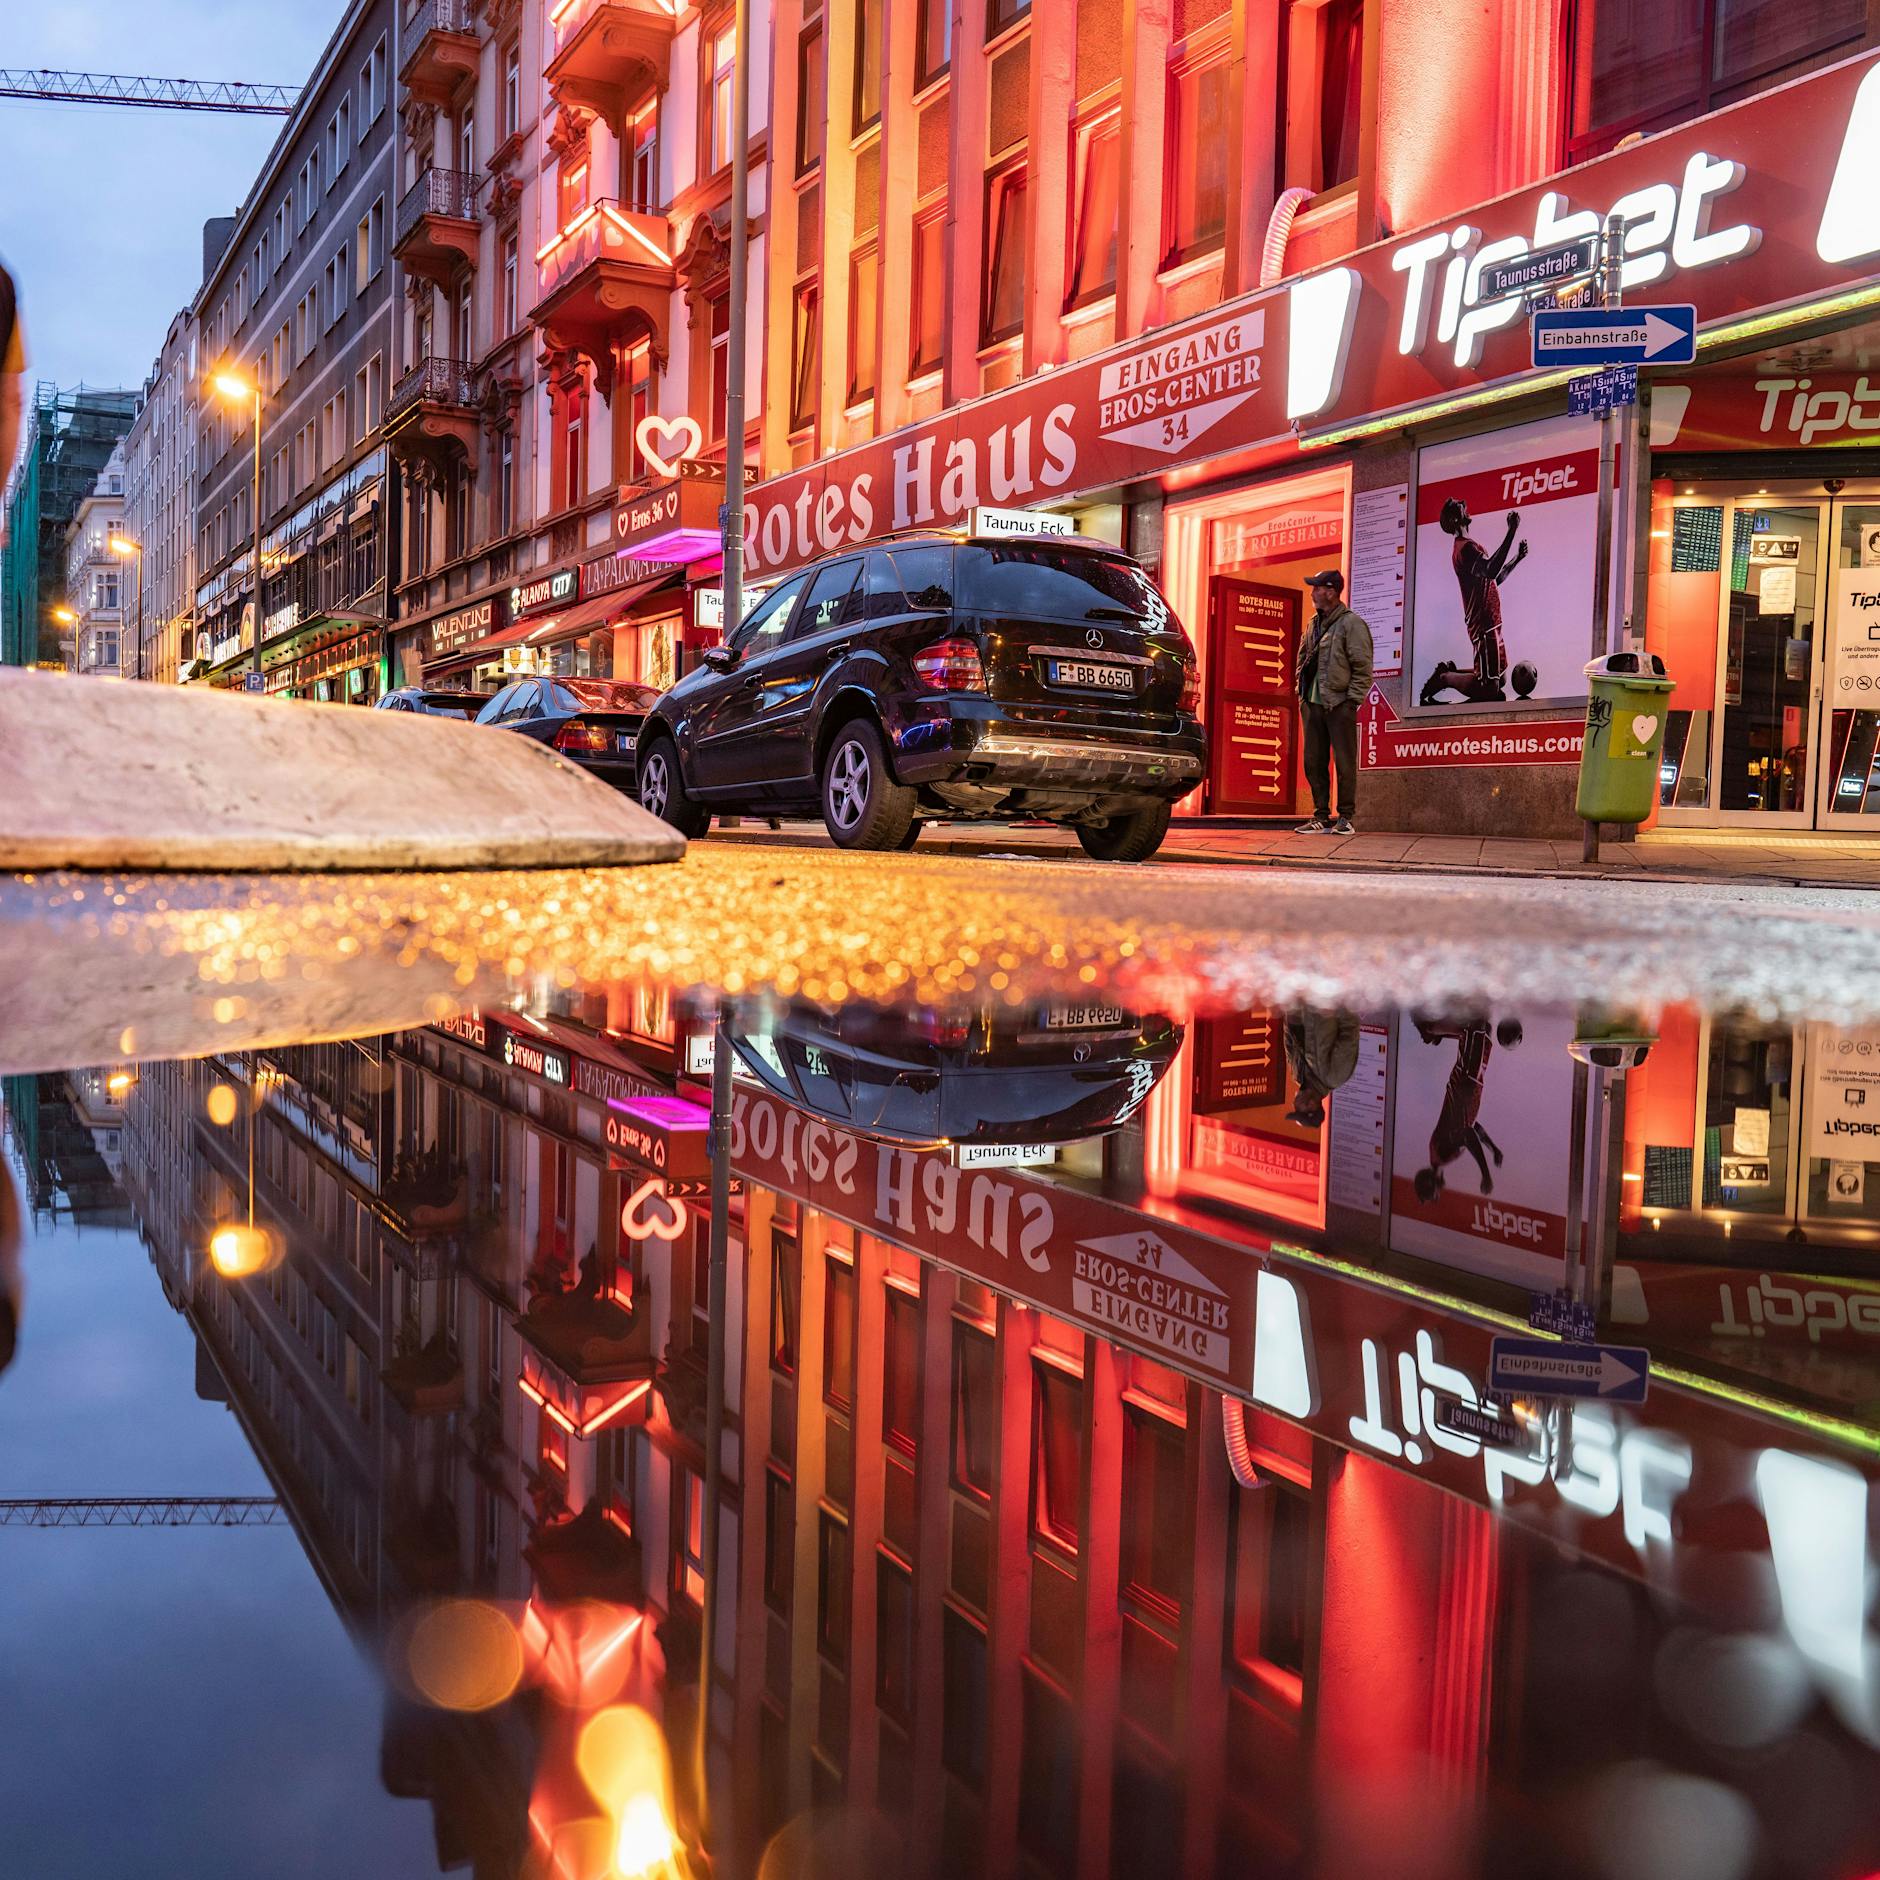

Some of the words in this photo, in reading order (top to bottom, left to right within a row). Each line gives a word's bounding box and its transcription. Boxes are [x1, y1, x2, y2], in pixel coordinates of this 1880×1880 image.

[1391, 152, 1757, 368] Tipbet
[1495, 251, 1579, 290] Taunusstraße
[1543, 330, 1648, 346] Einbahnstraße
[1118, 324, 1242, 390] EINGANG
[1099, 355, 1261, 429] EROS-CENTER
[1161, 412, 1190, 445] 34
[892, 403, 1077, 531] Haus
[1501, 465, 1579, 504] Tipbet
[631, 509, 651, 532] Eros
[651, 499, 664, 524] 36
[983, 514, 1036, 533] Taunus
[1040, 520, 1065, 536] Eck
[521, 581, 550, 607] ALANYA
[552, 573, 572, 598] CITY
[1239, 594, 1263, 607] ROTES
[1263, 599, 1284, 610] HAUS
[1850, 592, 1880, 610] Tip
[432, 605, 492, 640] VALENTINO
[250, 675, 260, 688] P
[1058, 664, 1067, 682] F
[1077, 666, 1094, 683] BB
[1099, 672, 1131, 688] 6650
[1367, 690, 1380, 765] GIRLS
[1394, 735, 1584, 757] www.roteshaus.com
